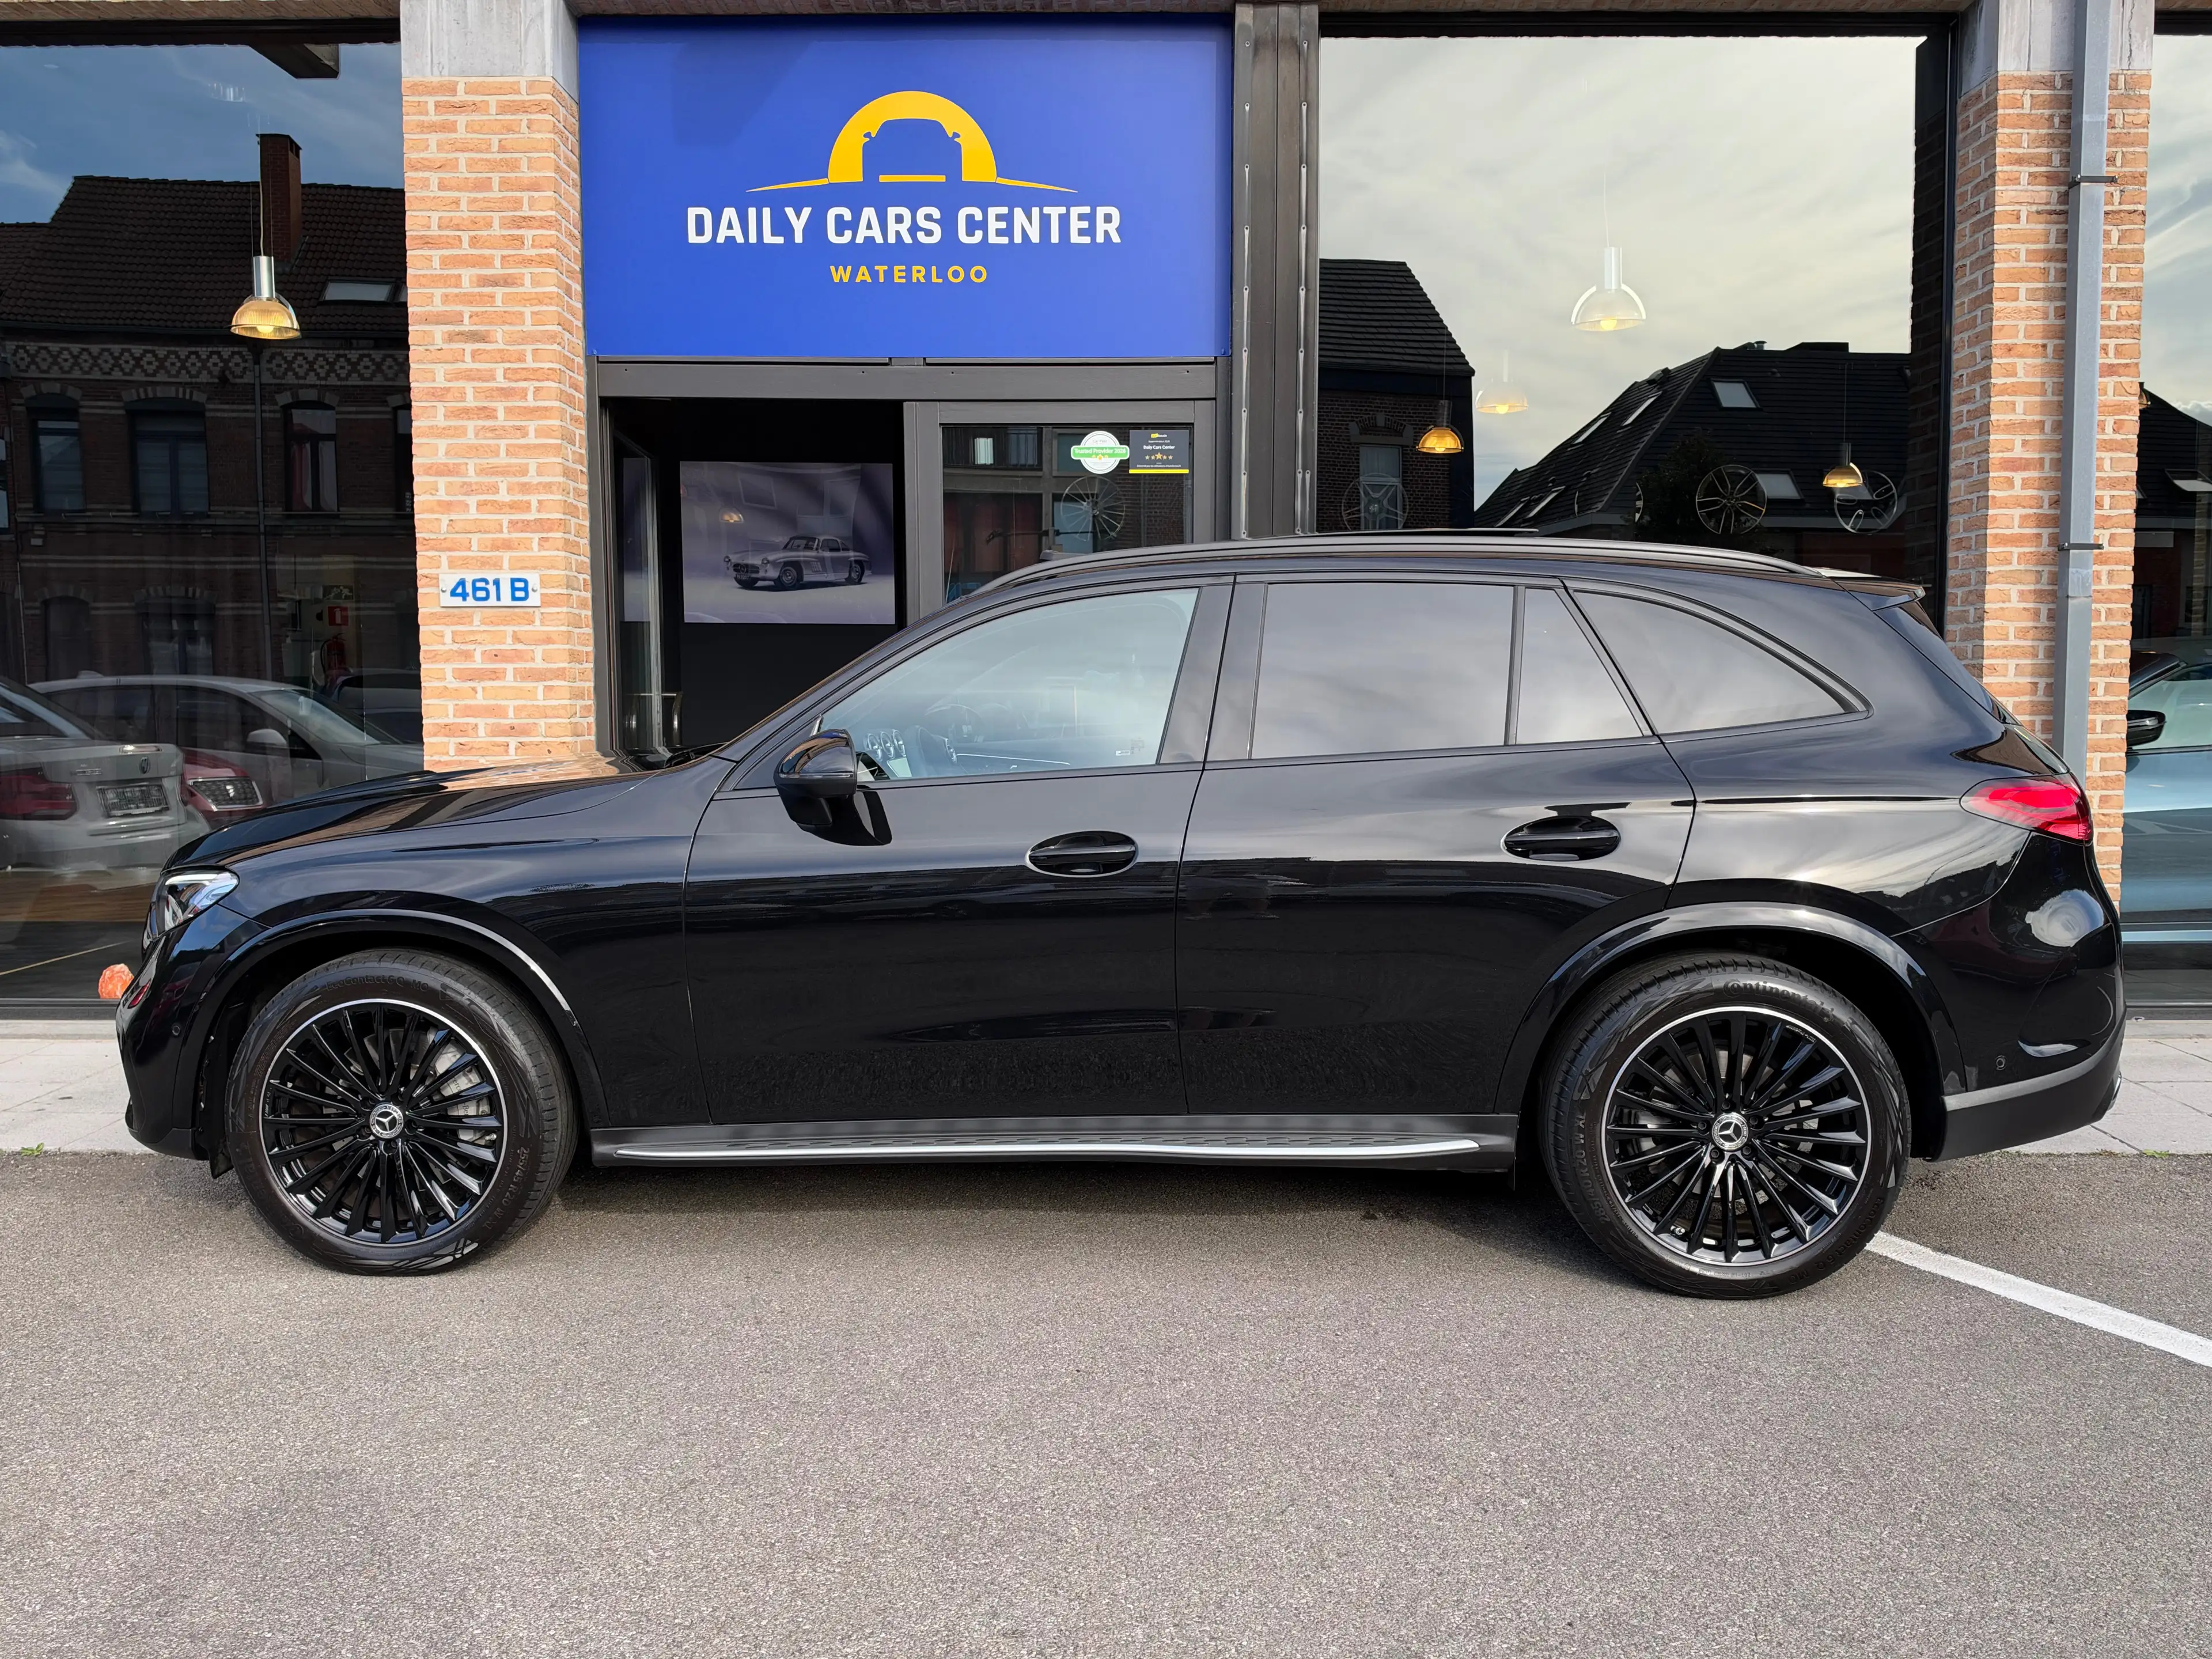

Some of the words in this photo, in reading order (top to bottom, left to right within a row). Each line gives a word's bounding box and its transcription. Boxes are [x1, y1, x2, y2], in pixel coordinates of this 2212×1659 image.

[687, 207, 812, 243] DAILY
[827, 206, 942, 243] CARS
[957, 206, 1122, 244] CENTER
[831, 265, 987, 283] WATERLOO
[450, 578, 501, 602] 461
[510, 577, 529, 601] B
[325, 975, 388, 992] EcoContact
[1723, 979, 1825, 1015] Continental
[1574, 1110, 1586, 1129] XL
[1573, 1132, 1585, 1145] W
[513, 1146, 531, 1183] 255/45
[1580, 1178, 1612, 1224] 285/40
[1835, 1196, 1885, 1257] EcoContact
[1788, 1268, 1810, 1285] MO
